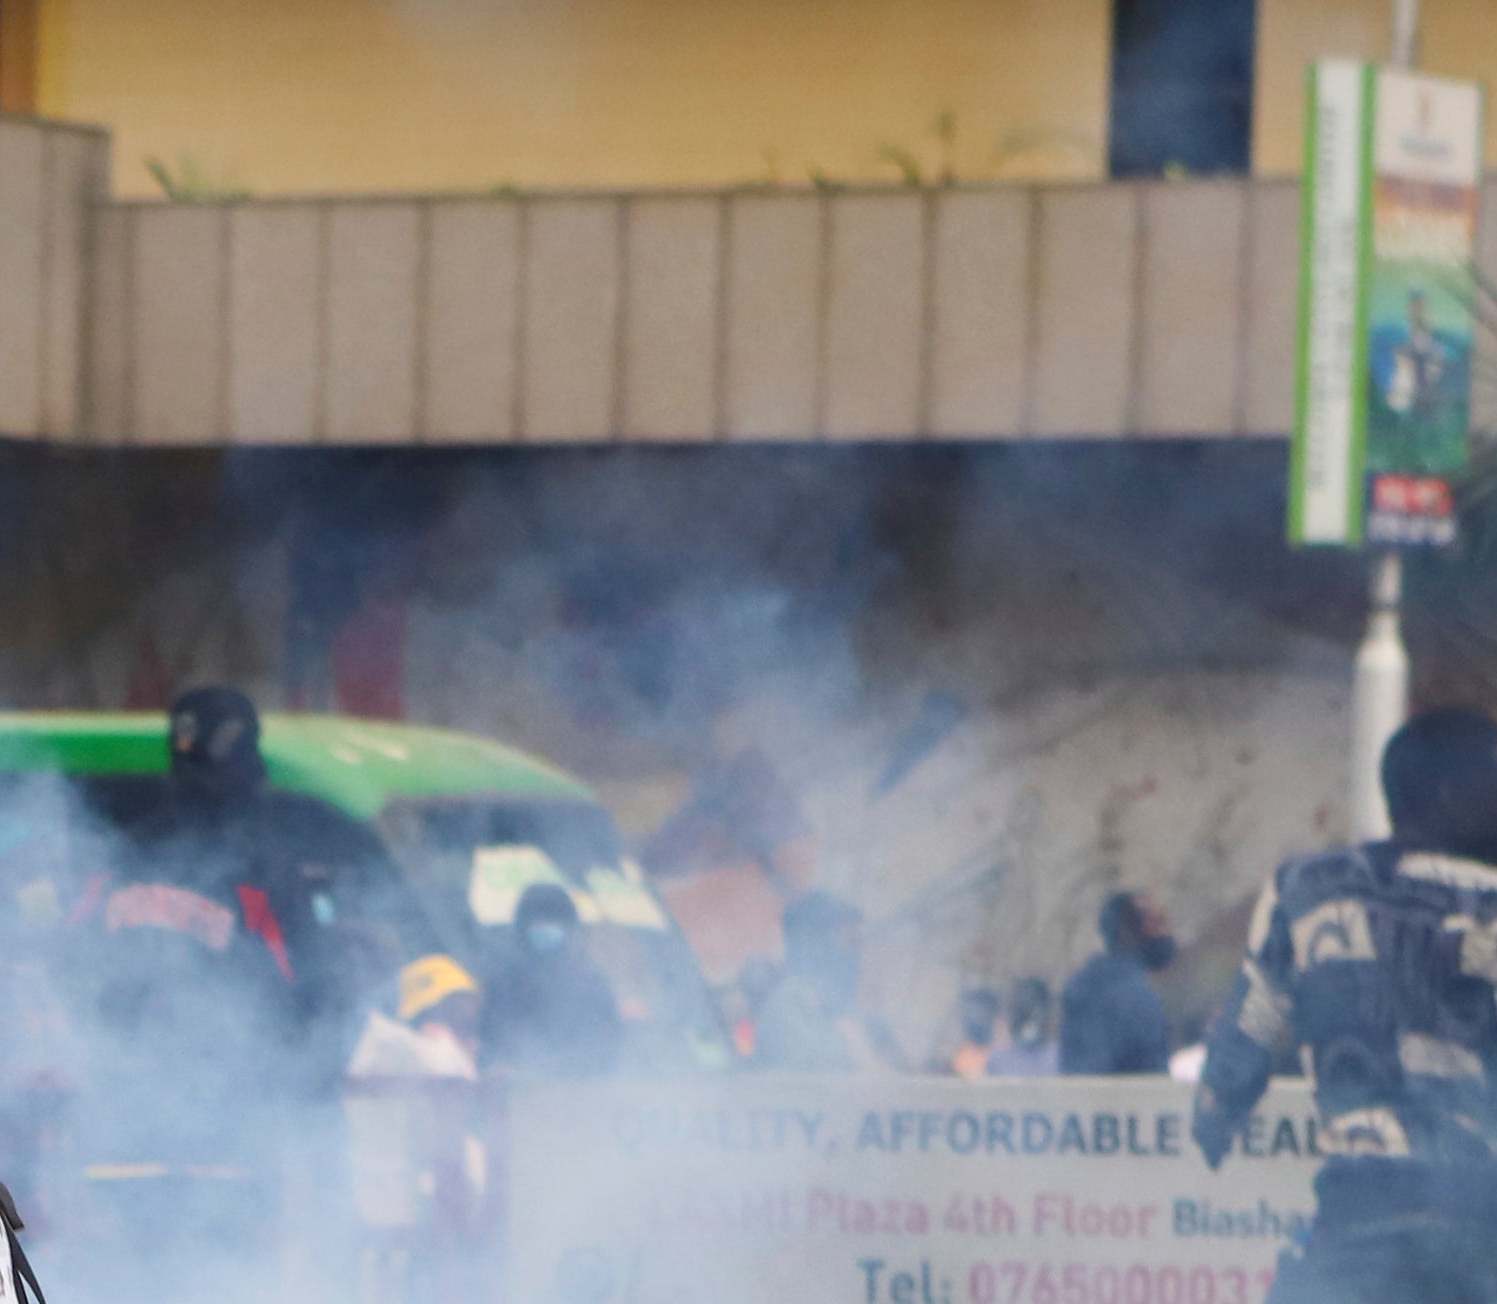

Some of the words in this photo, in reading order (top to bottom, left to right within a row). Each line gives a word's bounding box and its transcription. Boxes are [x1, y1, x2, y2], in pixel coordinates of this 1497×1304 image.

[855, 1110, 1183, 1157] AFFORDABLE
[807, 1187, 930, 1235] Plaza
[942, 1192, 1016, 1236] 4th
[1032, 1194, 1156, 1239] Floor
[1172, 1196, 1307, 1239] Biasha
